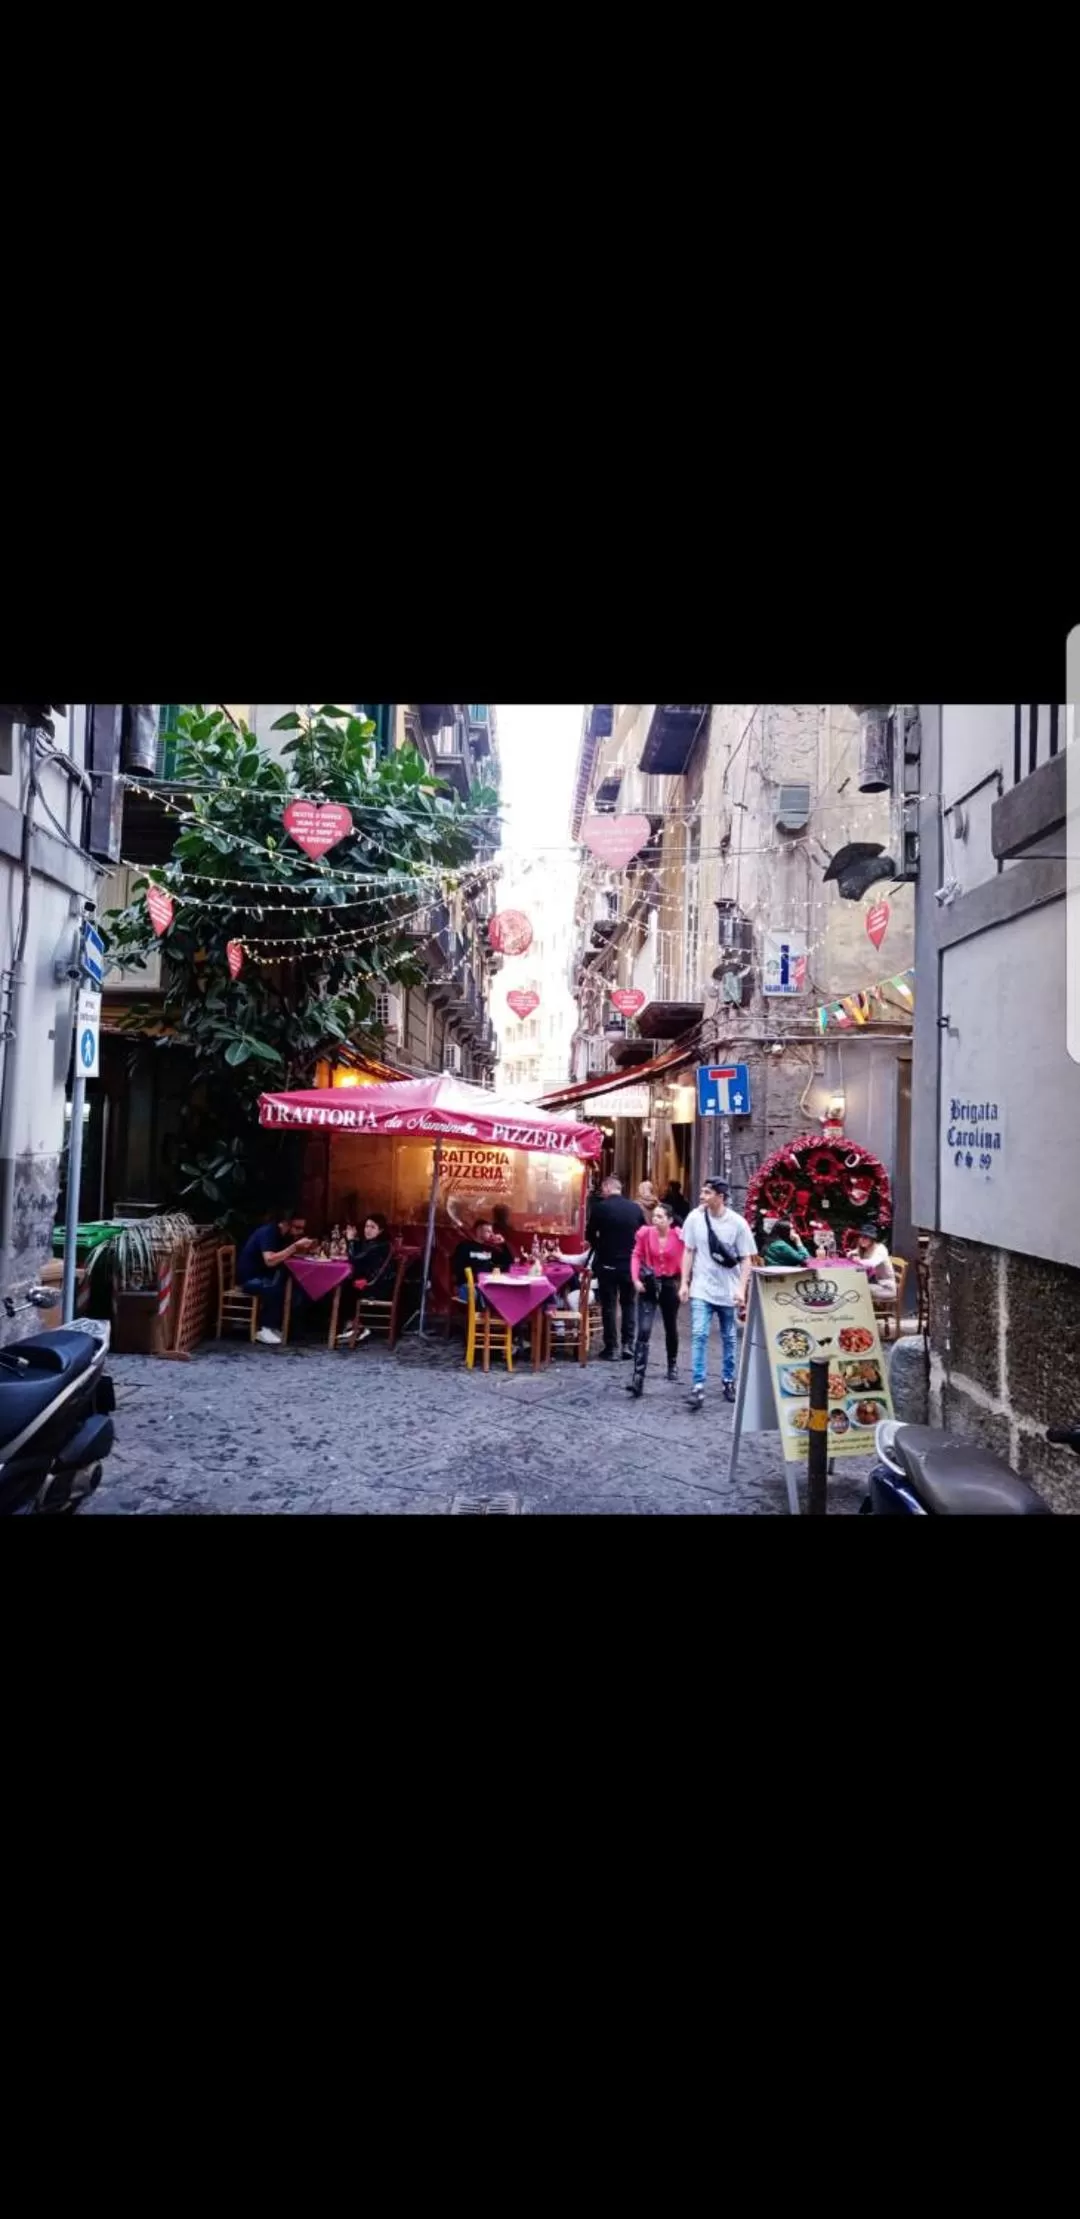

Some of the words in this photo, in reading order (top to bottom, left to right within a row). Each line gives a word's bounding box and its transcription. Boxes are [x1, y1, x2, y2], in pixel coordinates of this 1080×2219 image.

[950, 1098, 998, 1124] Brigata
[262, 1103, 378, 1128] TRATTORIA
[490, 1123, 580, 1153] PIZZERIA
[947, 1126, 1001, 1149] Carolina
[438, 1164, 504, 1179] PIZZERIA
